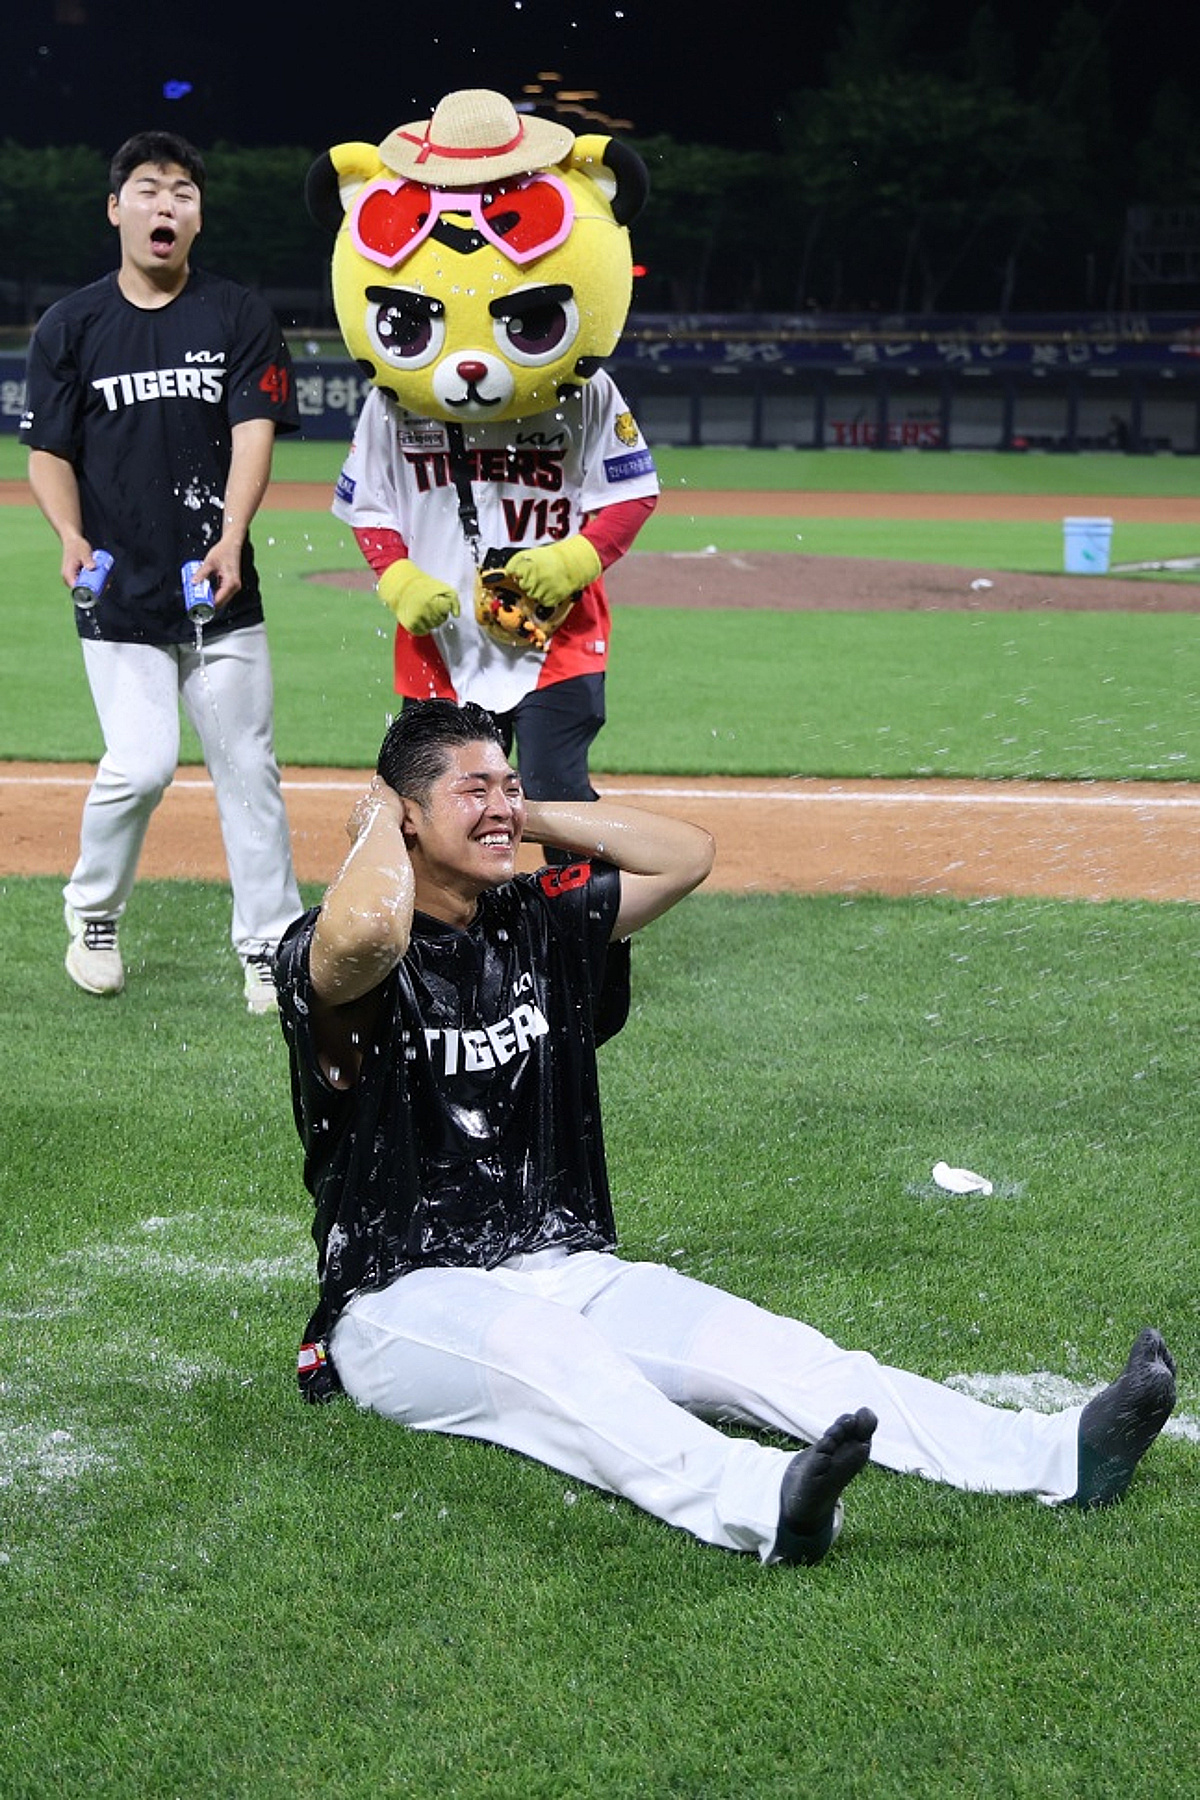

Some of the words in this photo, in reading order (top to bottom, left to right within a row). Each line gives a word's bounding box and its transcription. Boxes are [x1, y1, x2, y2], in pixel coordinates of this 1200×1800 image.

[185, 351, 225, 363] KIA
[92, 368, 227, 411] TIGERS
[259, 364, 288, 403] 41
[502, 497, 571, 542] V13
